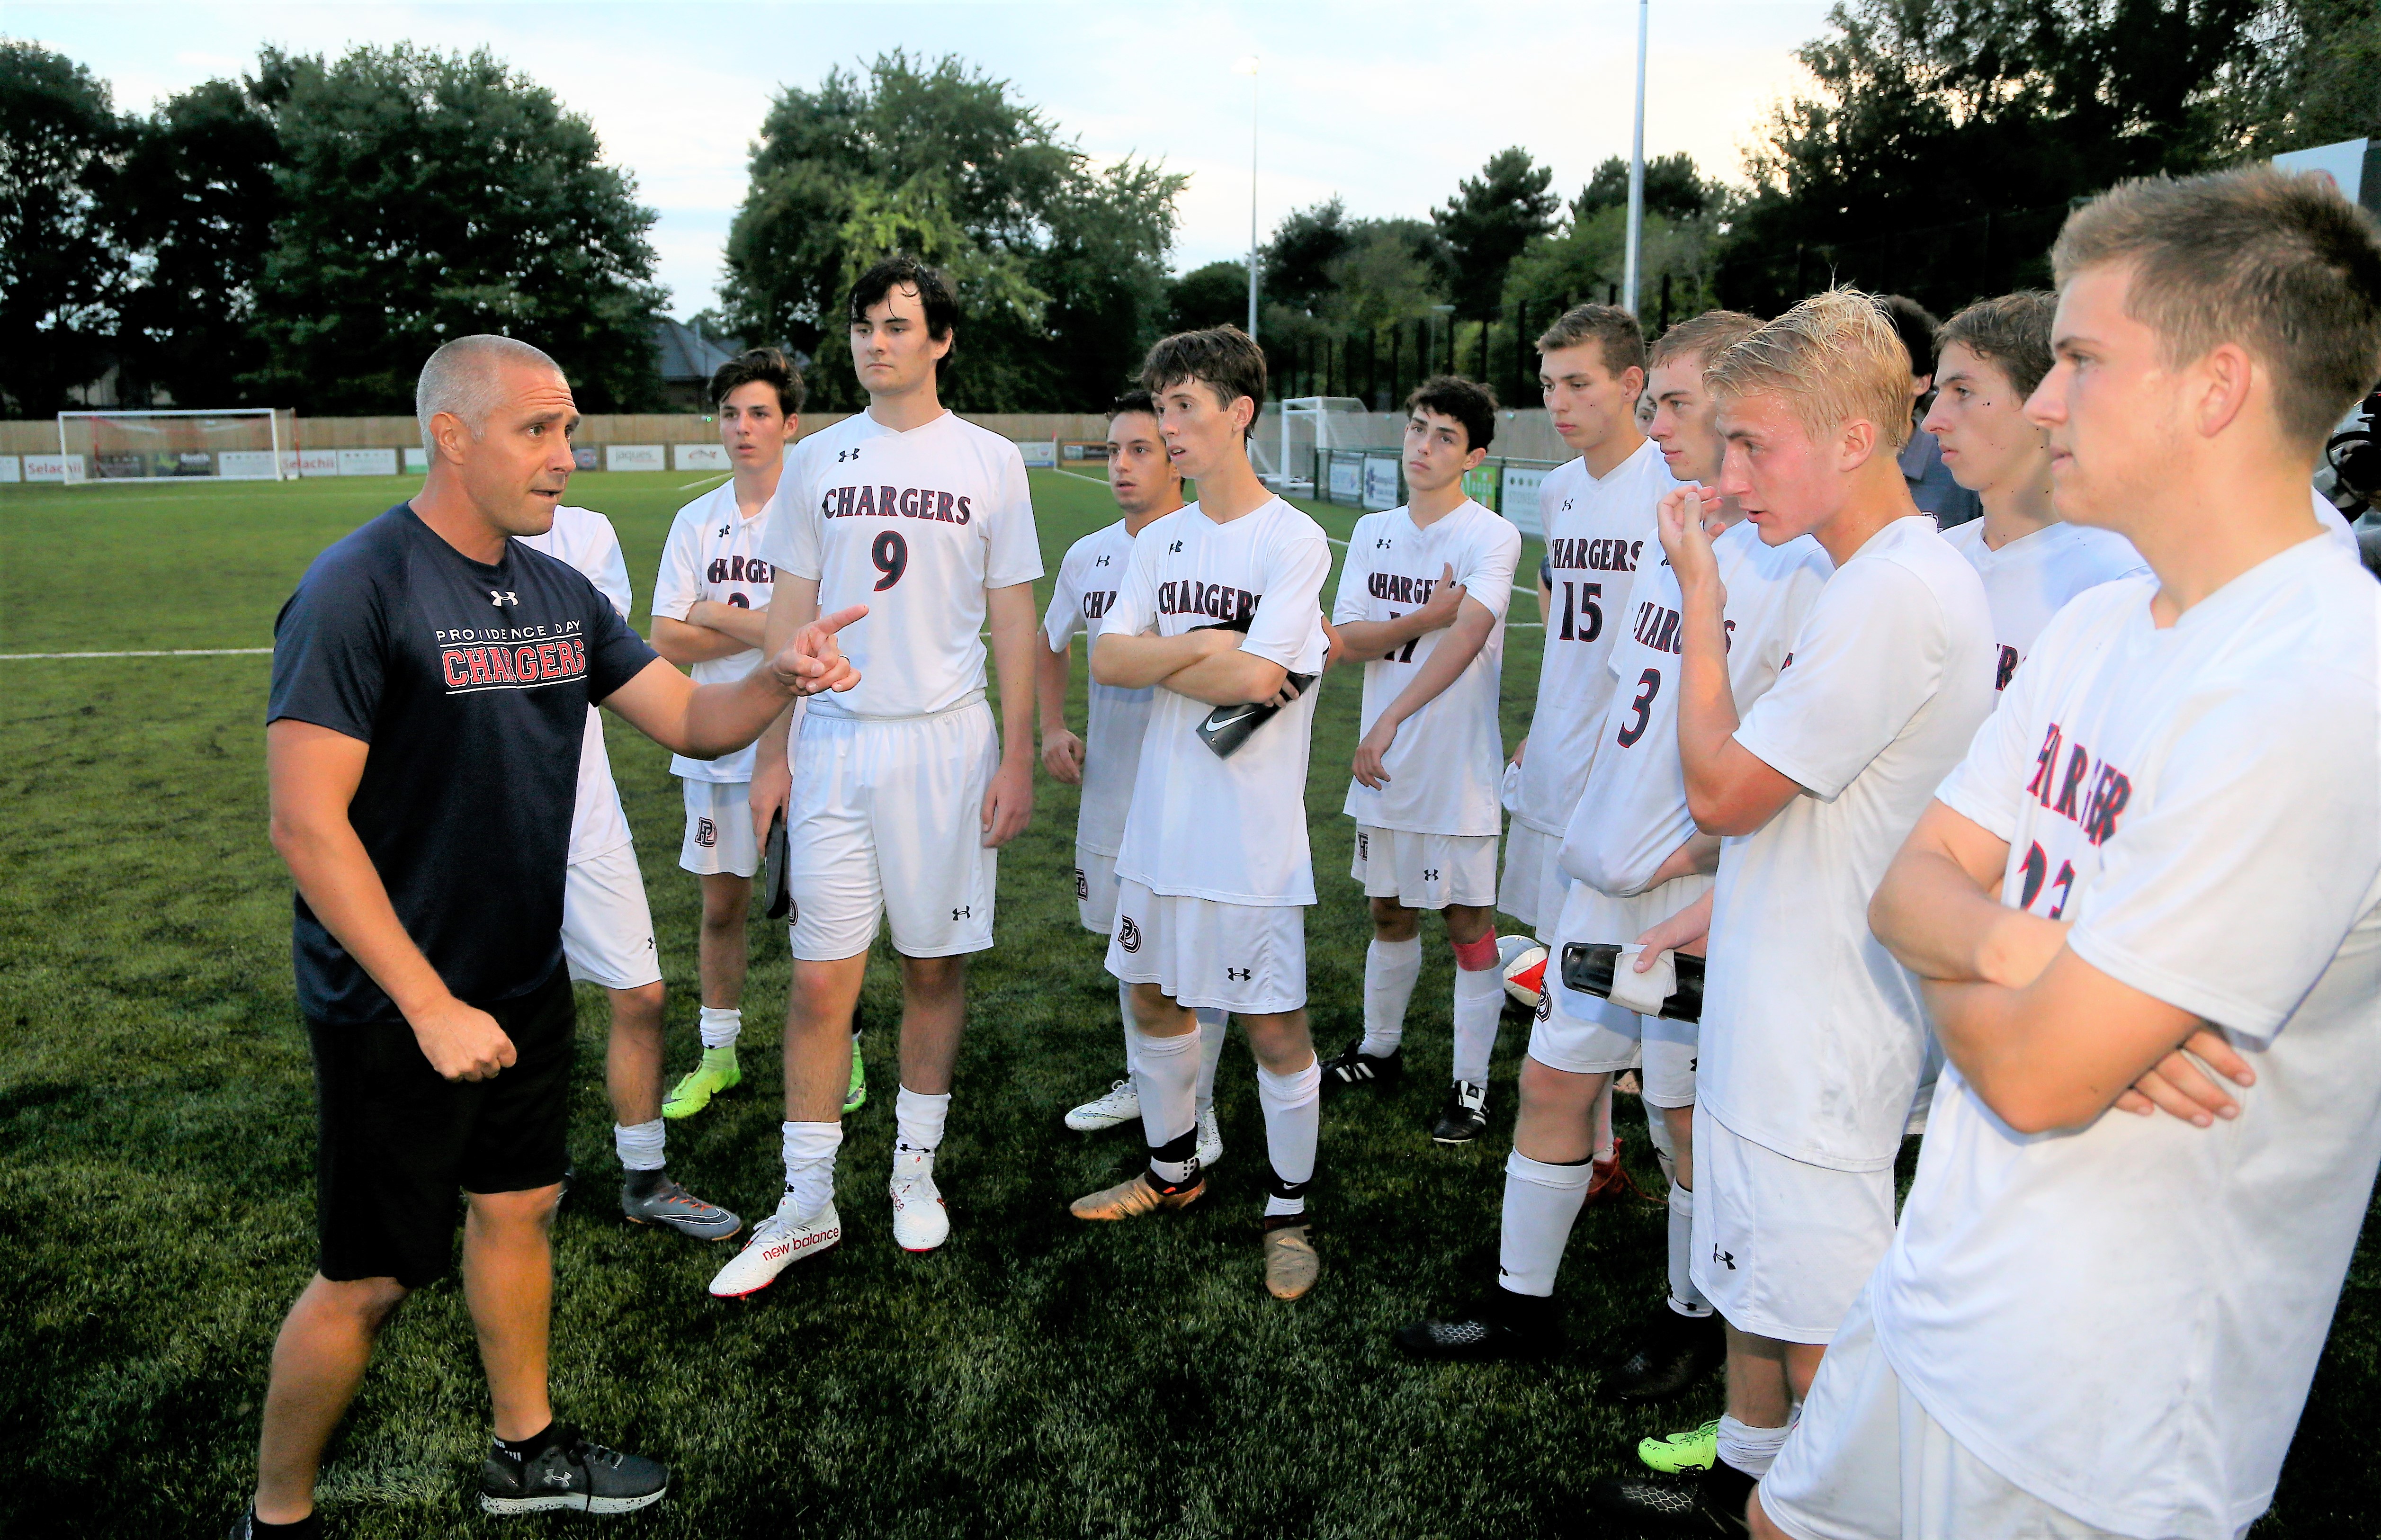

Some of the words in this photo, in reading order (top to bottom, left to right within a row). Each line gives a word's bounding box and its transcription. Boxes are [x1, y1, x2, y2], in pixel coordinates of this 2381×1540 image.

[282, 457, 334, 469] Seachii
[822, 486, 971, 525] CHARGERS
[872, 530, 908, 591] 9
[1553, 538, 1644, 571] HARGERS
[1158, 580, 1262, 620] CHARGER
[1559, 582, 1603, 643] 15
[555, 620, 580, 634] DAY
[442, 639, 586, 688] CHARGERS
[1617, 668, 1661, 749] 3
[762, 1243, 789, 1261] new
[792, 1227, 839, 1250] balance
